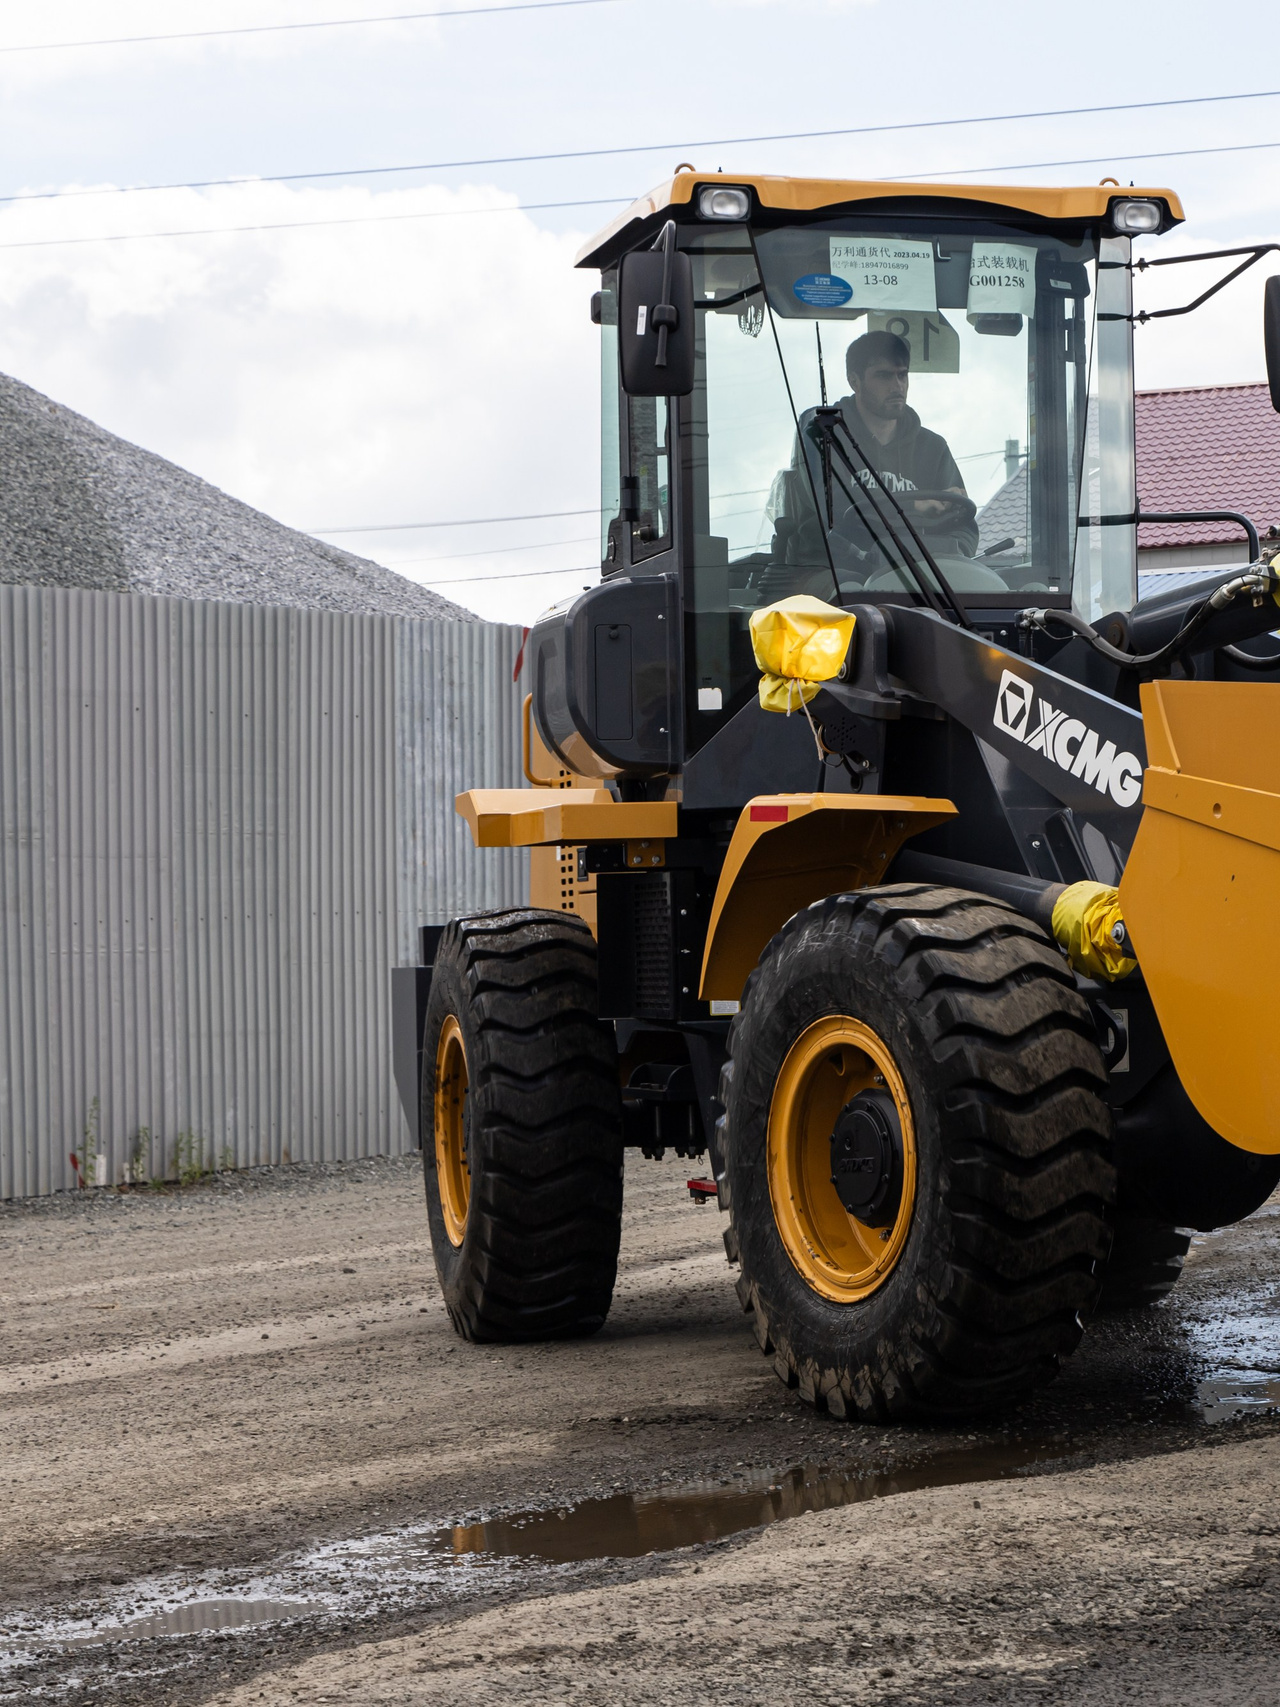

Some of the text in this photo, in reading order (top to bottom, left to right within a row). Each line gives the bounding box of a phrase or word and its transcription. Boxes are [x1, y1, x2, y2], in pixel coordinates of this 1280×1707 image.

[832, 246, 930, 259] 万利通货代 2023.04.19
[863, 274, 898, 286] 13-08
[969, 275, 1025, 288] G001258
[1022, 697, 1143, 808] XCMG
